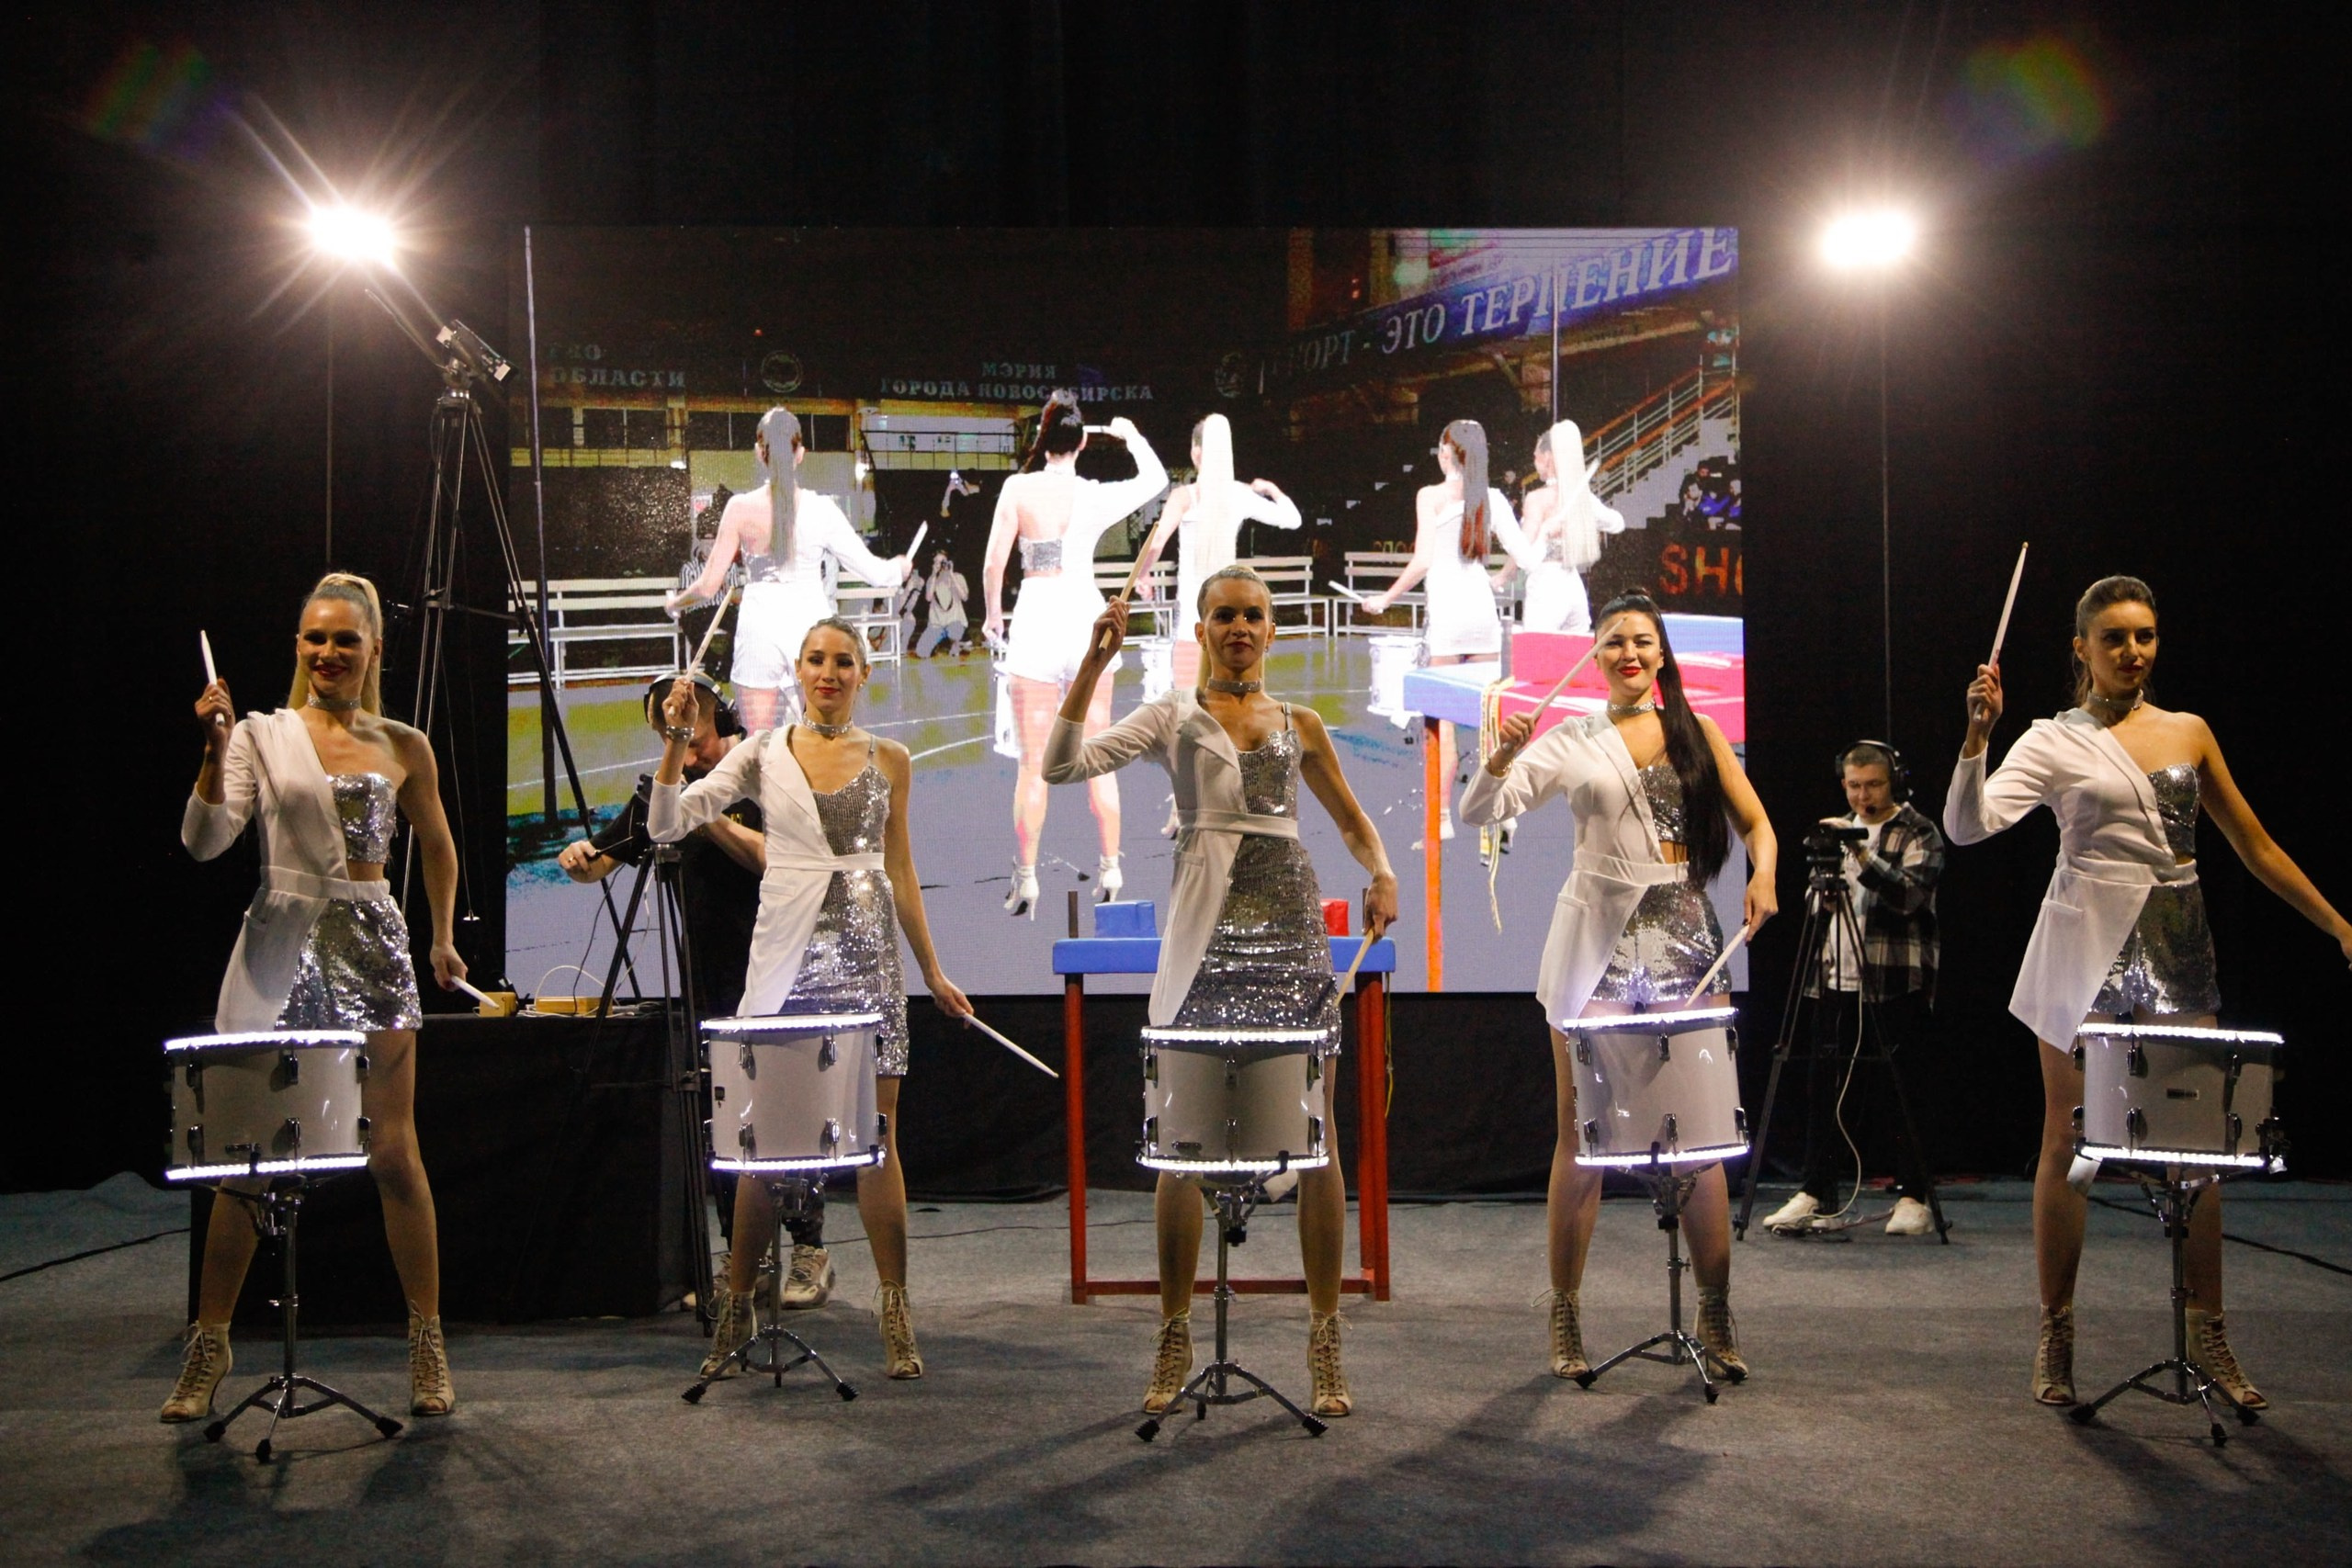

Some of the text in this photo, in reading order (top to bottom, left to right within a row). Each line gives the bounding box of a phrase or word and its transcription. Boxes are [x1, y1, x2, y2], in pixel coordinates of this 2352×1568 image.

[1381, 303, 1446, 355] ЭТО
[1461, 228, 1733, 335] ТЕРПЕНИЕ
[552, 367, 686, 389] ОБЛАСТИ
[981, 362, 1056, 379] МЭРИЯ
[880, 378, 970, 399] ГОРОДА
